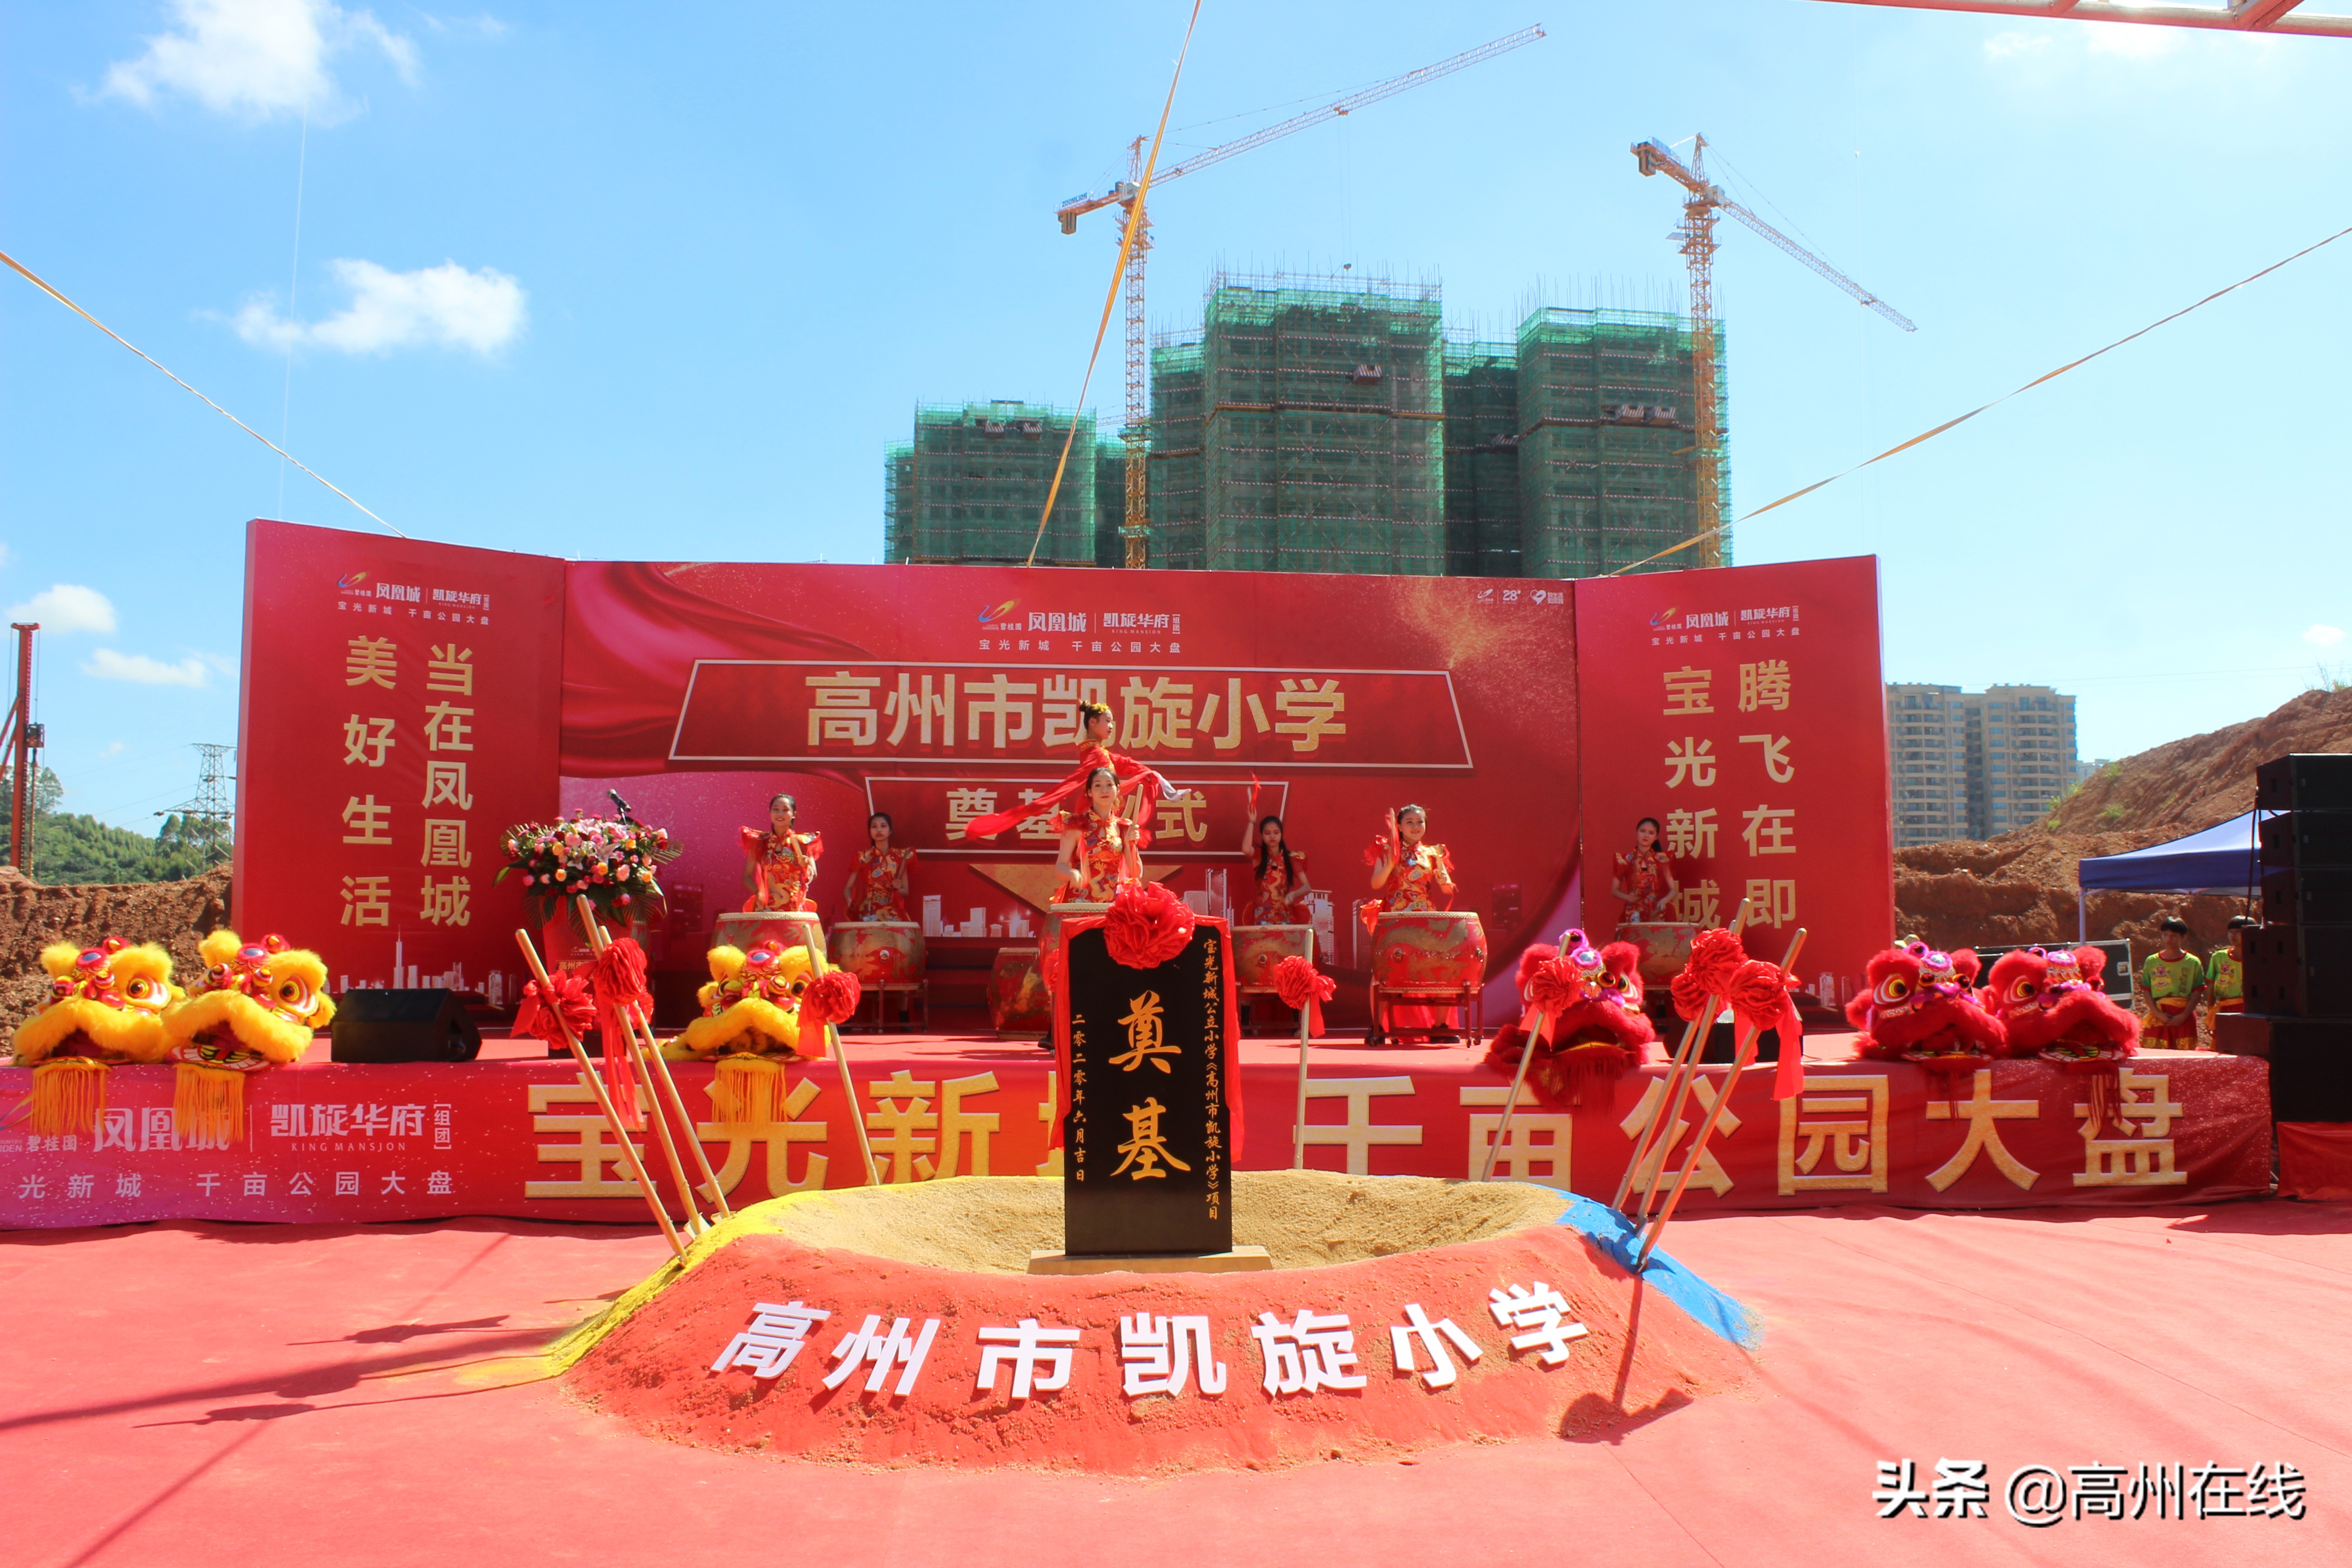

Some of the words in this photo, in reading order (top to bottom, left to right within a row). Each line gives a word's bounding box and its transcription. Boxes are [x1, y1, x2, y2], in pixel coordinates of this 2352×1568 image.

[1062, 192, 1087, 207] ZOOMLION
[338, 601, 392, 615] 宝光新城
[408, 609, 489, 625] 千亩公园大盘
[376, 583, 421, 603] 凤凰城
[433, 588, 481, 605] 凯旋华府
[1028, 612, 1087, 632] 凤凰城
[1103, 612, 1169, 628] 凯旋华府
[1651, 634, 1703, 646] 宝光新城
[1718, 627, 1800, 641] 千亩公园大盘
[1686, 612, 1729, 629] 凤凰城
[1740, 607, 1791, 621] 凯旋华府
[979, 639, 1050, 652] 宝光新城
[1072, 641, 1181, 653] 千亩公园大盘
[805, 671, 1347, 752] 高州市凯旋小学
[340, 635, 397, 927] 美好生活
[420, 643, 474, 927] 当在凤凰城
[1662, 666, 1721, 930] 宝光新城
[1738, 659, 1797, 930] 腾飞在即
[945, 788, 1208, 843] 奠基式
[1072, 1014, 1088, 1182] 二零二零年六月吉日
[1108, 990, 1191, 1181] 奠基
[270, 1103, 426, 1137] 凯旋华府
[524, 1070, 1065, 1205] 宝光新
[1293, 1067, 2188, 1199] 千亩公园大盘
[292, 1142, 327, 1152] KING
[196, 1171, 452, 1197] 千亩公园大盘
[709, 1280, 1591, 1402] 高州市凯旋小学
